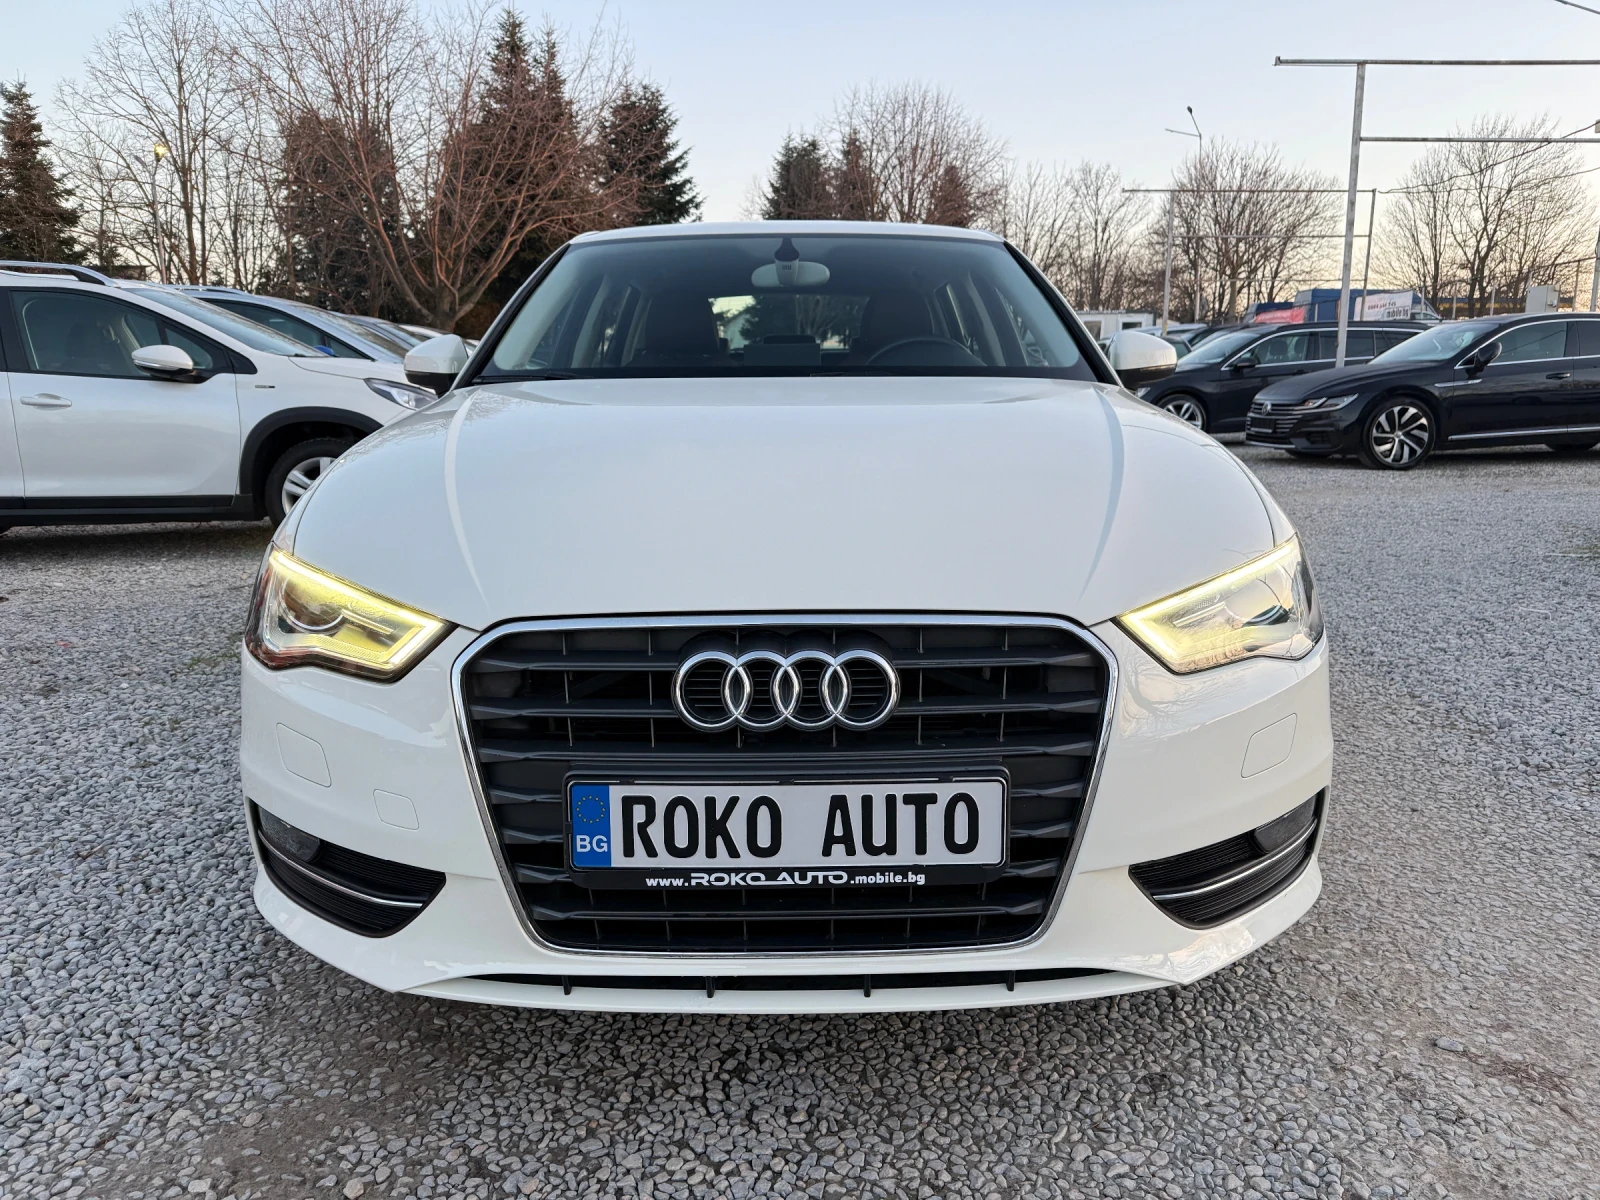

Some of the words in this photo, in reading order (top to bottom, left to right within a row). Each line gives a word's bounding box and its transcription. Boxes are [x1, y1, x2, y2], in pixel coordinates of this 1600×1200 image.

[576, 834, 608, 853] BG
[621, 795, 783, 859] ROKO
[821, 792, 980, 858] AUTO
